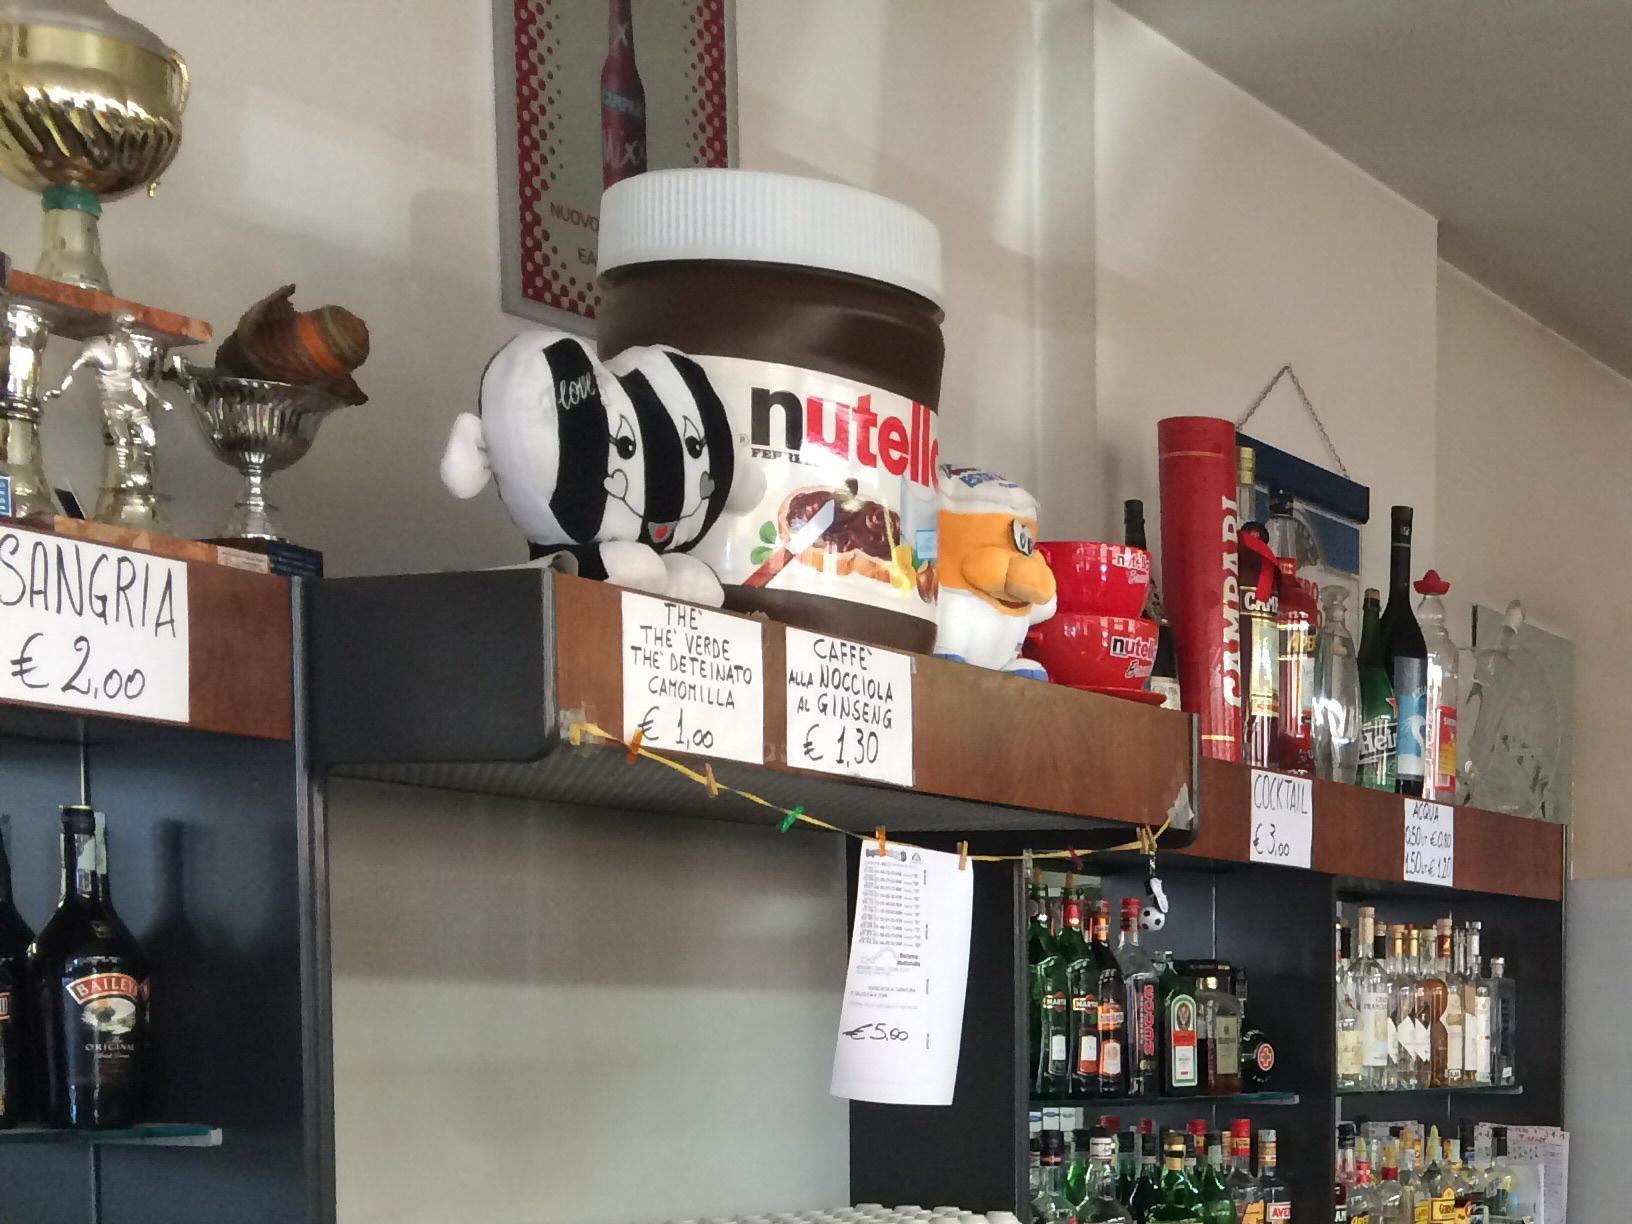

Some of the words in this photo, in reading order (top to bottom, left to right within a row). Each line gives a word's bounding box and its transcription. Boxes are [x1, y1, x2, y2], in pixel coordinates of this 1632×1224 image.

[551, 202, 599, 232] NUOVO
[558, 372, 596, 410] love
[0, 533, 176, 638] SANGRIA
[10, 633, 49, 688] €
[685, 633, 730, 661] VERDE
[670, 652, 752, 685] DETEINATO
[788, 669, 814, 689] ALLA
[819, 666, 893, 703] NOCCIOLA
[648, 676, 735, 710] CAMOMILLA
[797, 696, 810, 713] AL
[817, 693, 892, 729] GINSENG
[638, 706, 660, 741] €
[803, 724, 823, 761] €
[1254, 774, 1308, 814] COCKTAIL
[1412, 803, 1439, 823] ACQUA
